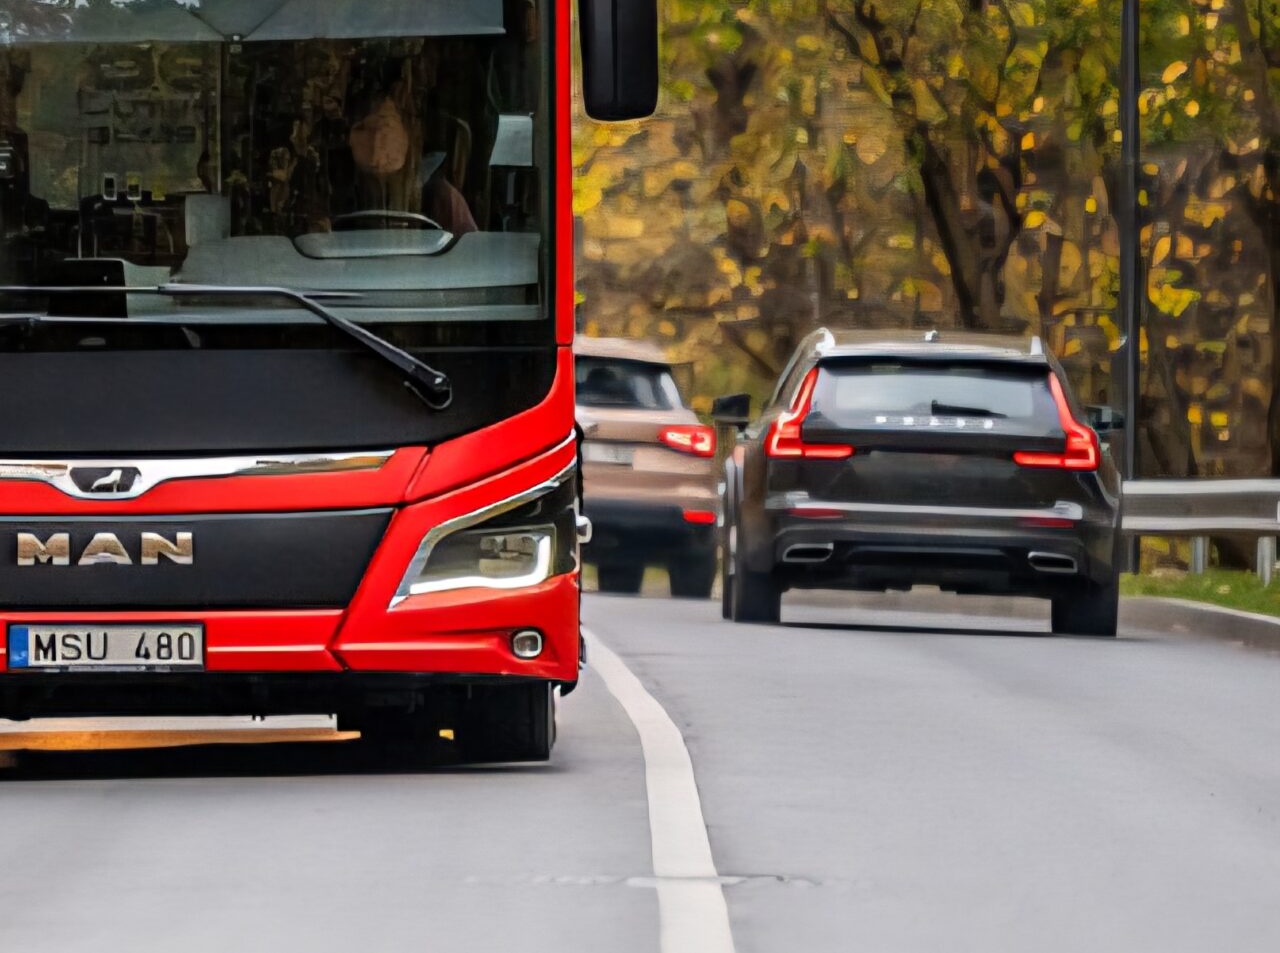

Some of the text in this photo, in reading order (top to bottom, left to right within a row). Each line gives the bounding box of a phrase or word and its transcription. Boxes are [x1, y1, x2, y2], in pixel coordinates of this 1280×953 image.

[17, 531, 194, 566] MAN
[34, 632, 195, 661] MSU 480
